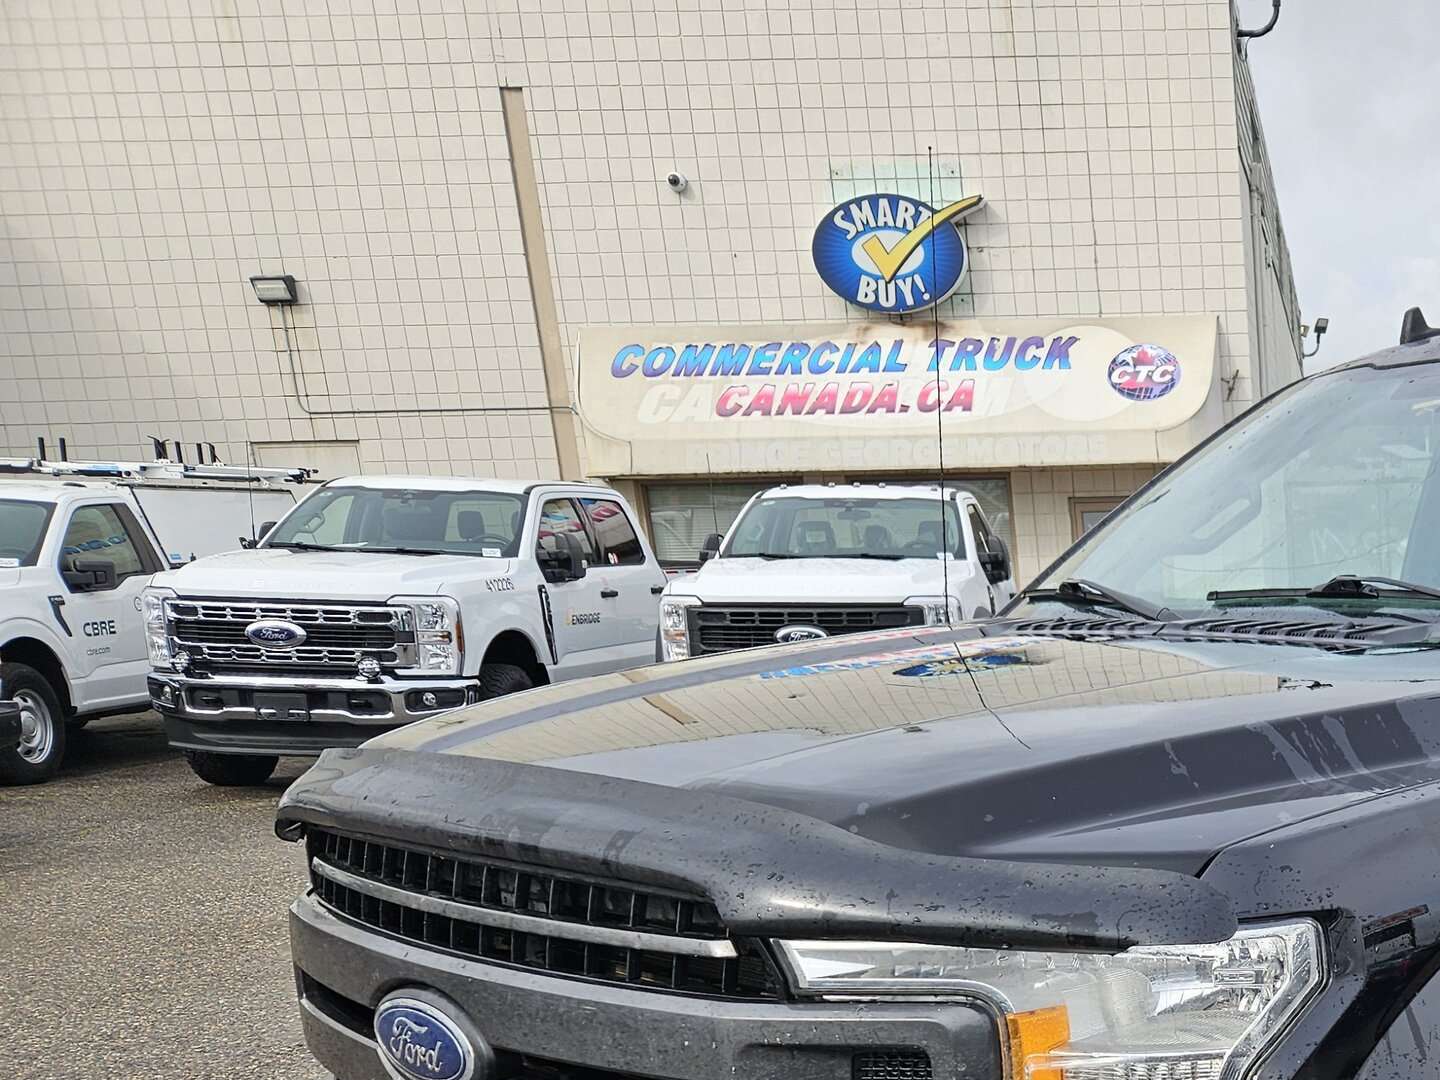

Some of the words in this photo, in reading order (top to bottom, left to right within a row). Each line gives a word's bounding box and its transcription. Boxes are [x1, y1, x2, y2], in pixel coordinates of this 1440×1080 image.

[833, 198, 932, 240] SMART
[857, 273, 931, 308] BUY!
[611, 339, 908, 379] COMMERCIAL
[926, 336, 1080, 373] TRUCK
[715, 378, 976, 418] CANADA.CA
[82, 619, 118, 637] CBRE
[260, 626, 289, 641] Ford
[389, 1015, 443, 1073] Ford
